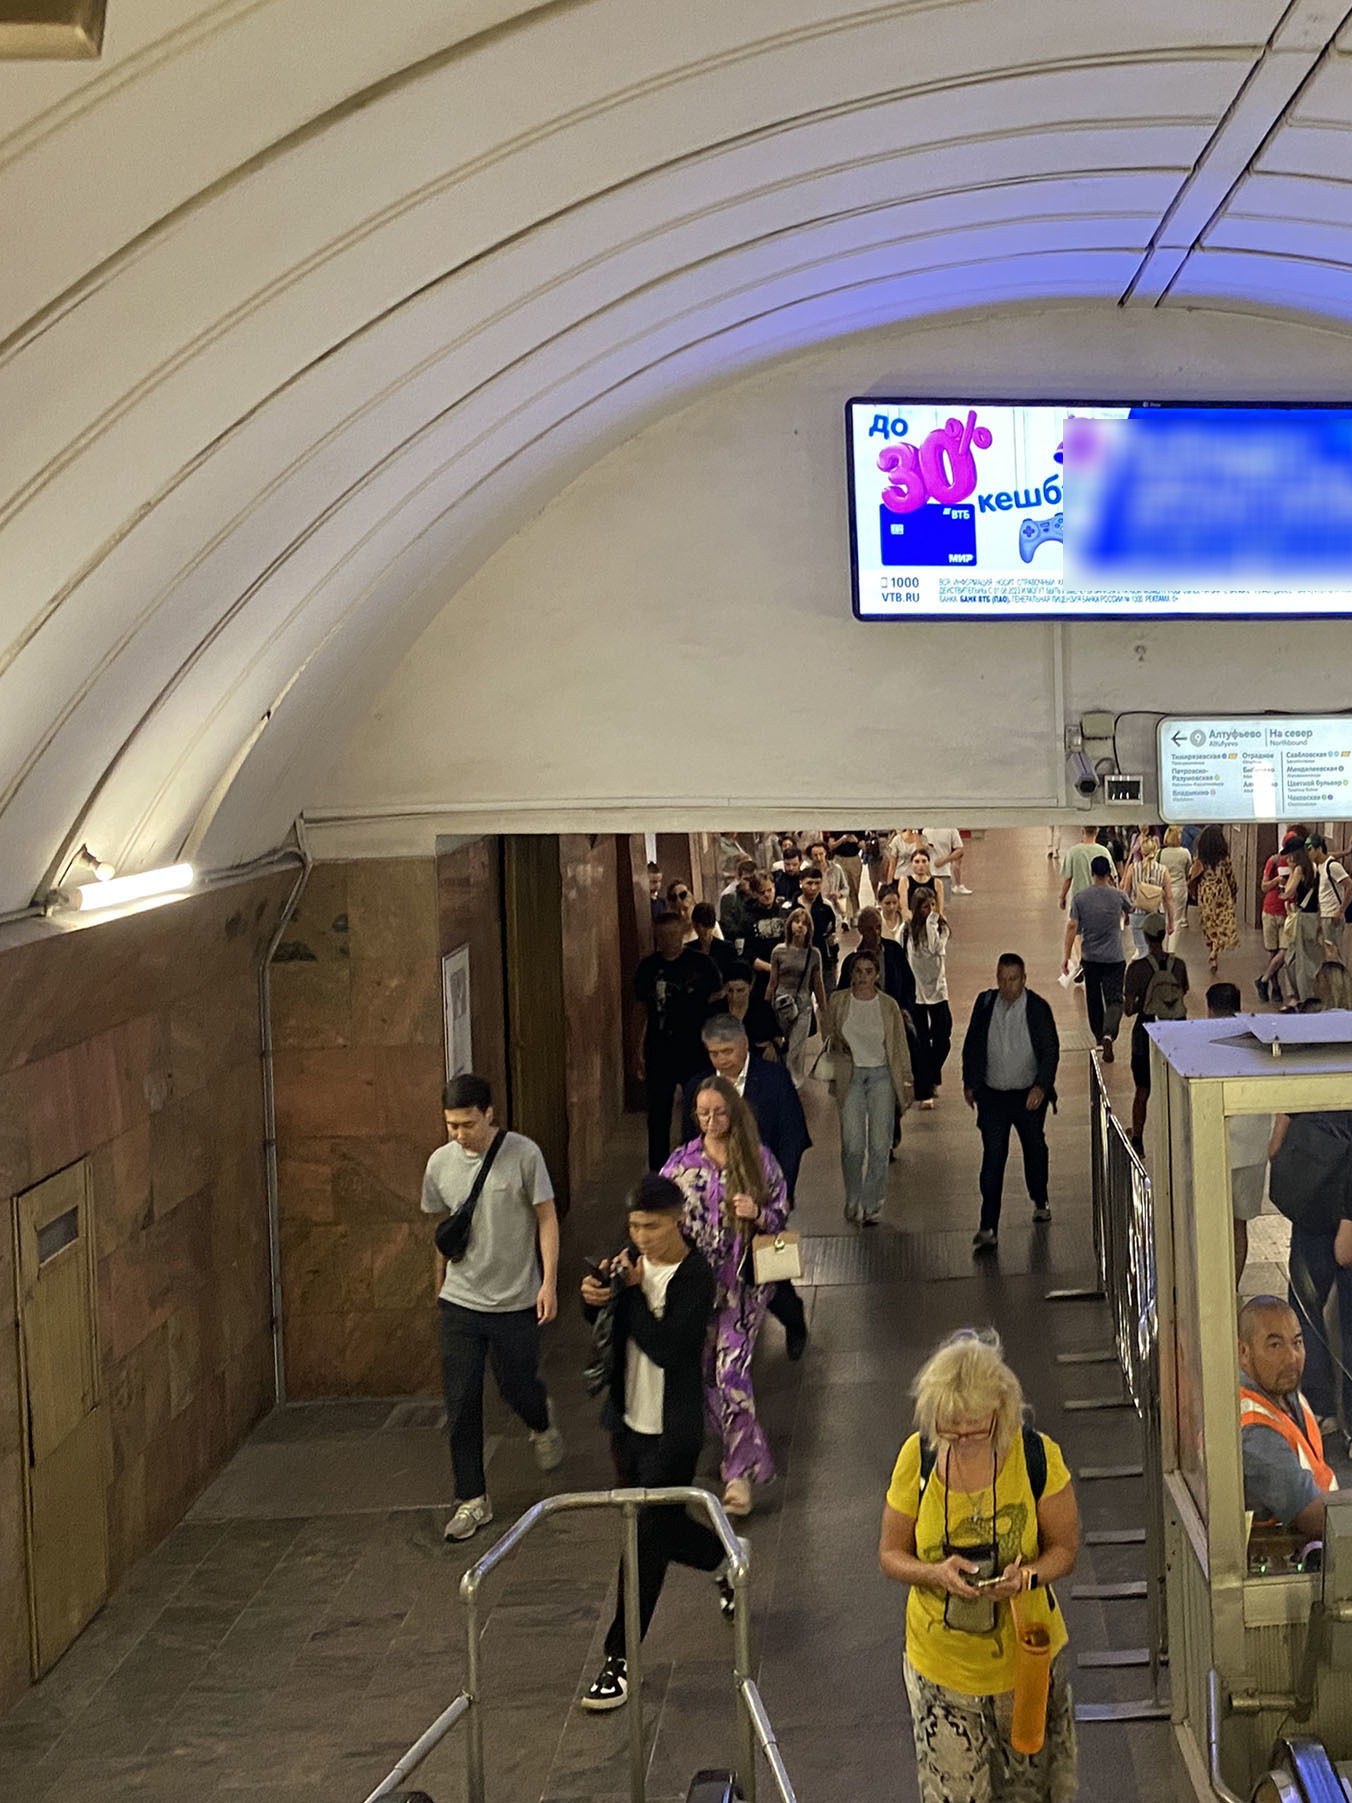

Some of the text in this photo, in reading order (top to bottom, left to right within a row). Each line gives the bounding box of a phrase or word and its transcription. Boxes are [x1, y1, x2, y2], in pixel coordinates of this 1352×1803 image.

[869, 413, 909, 440] до
[876, 409, 993, 514] 30%
[977, 473, 1063, 513] кешб
[951, 509, 970, 520] ВТБ
[948, 553, 974, 564] МИР
[891, 577, 920, 589] 1000
[881, 592, 921, 604] VTB.RU
[1208, 729, 1262, 741] Алтуфьево
[1269, 728, 1313, 739] На север
